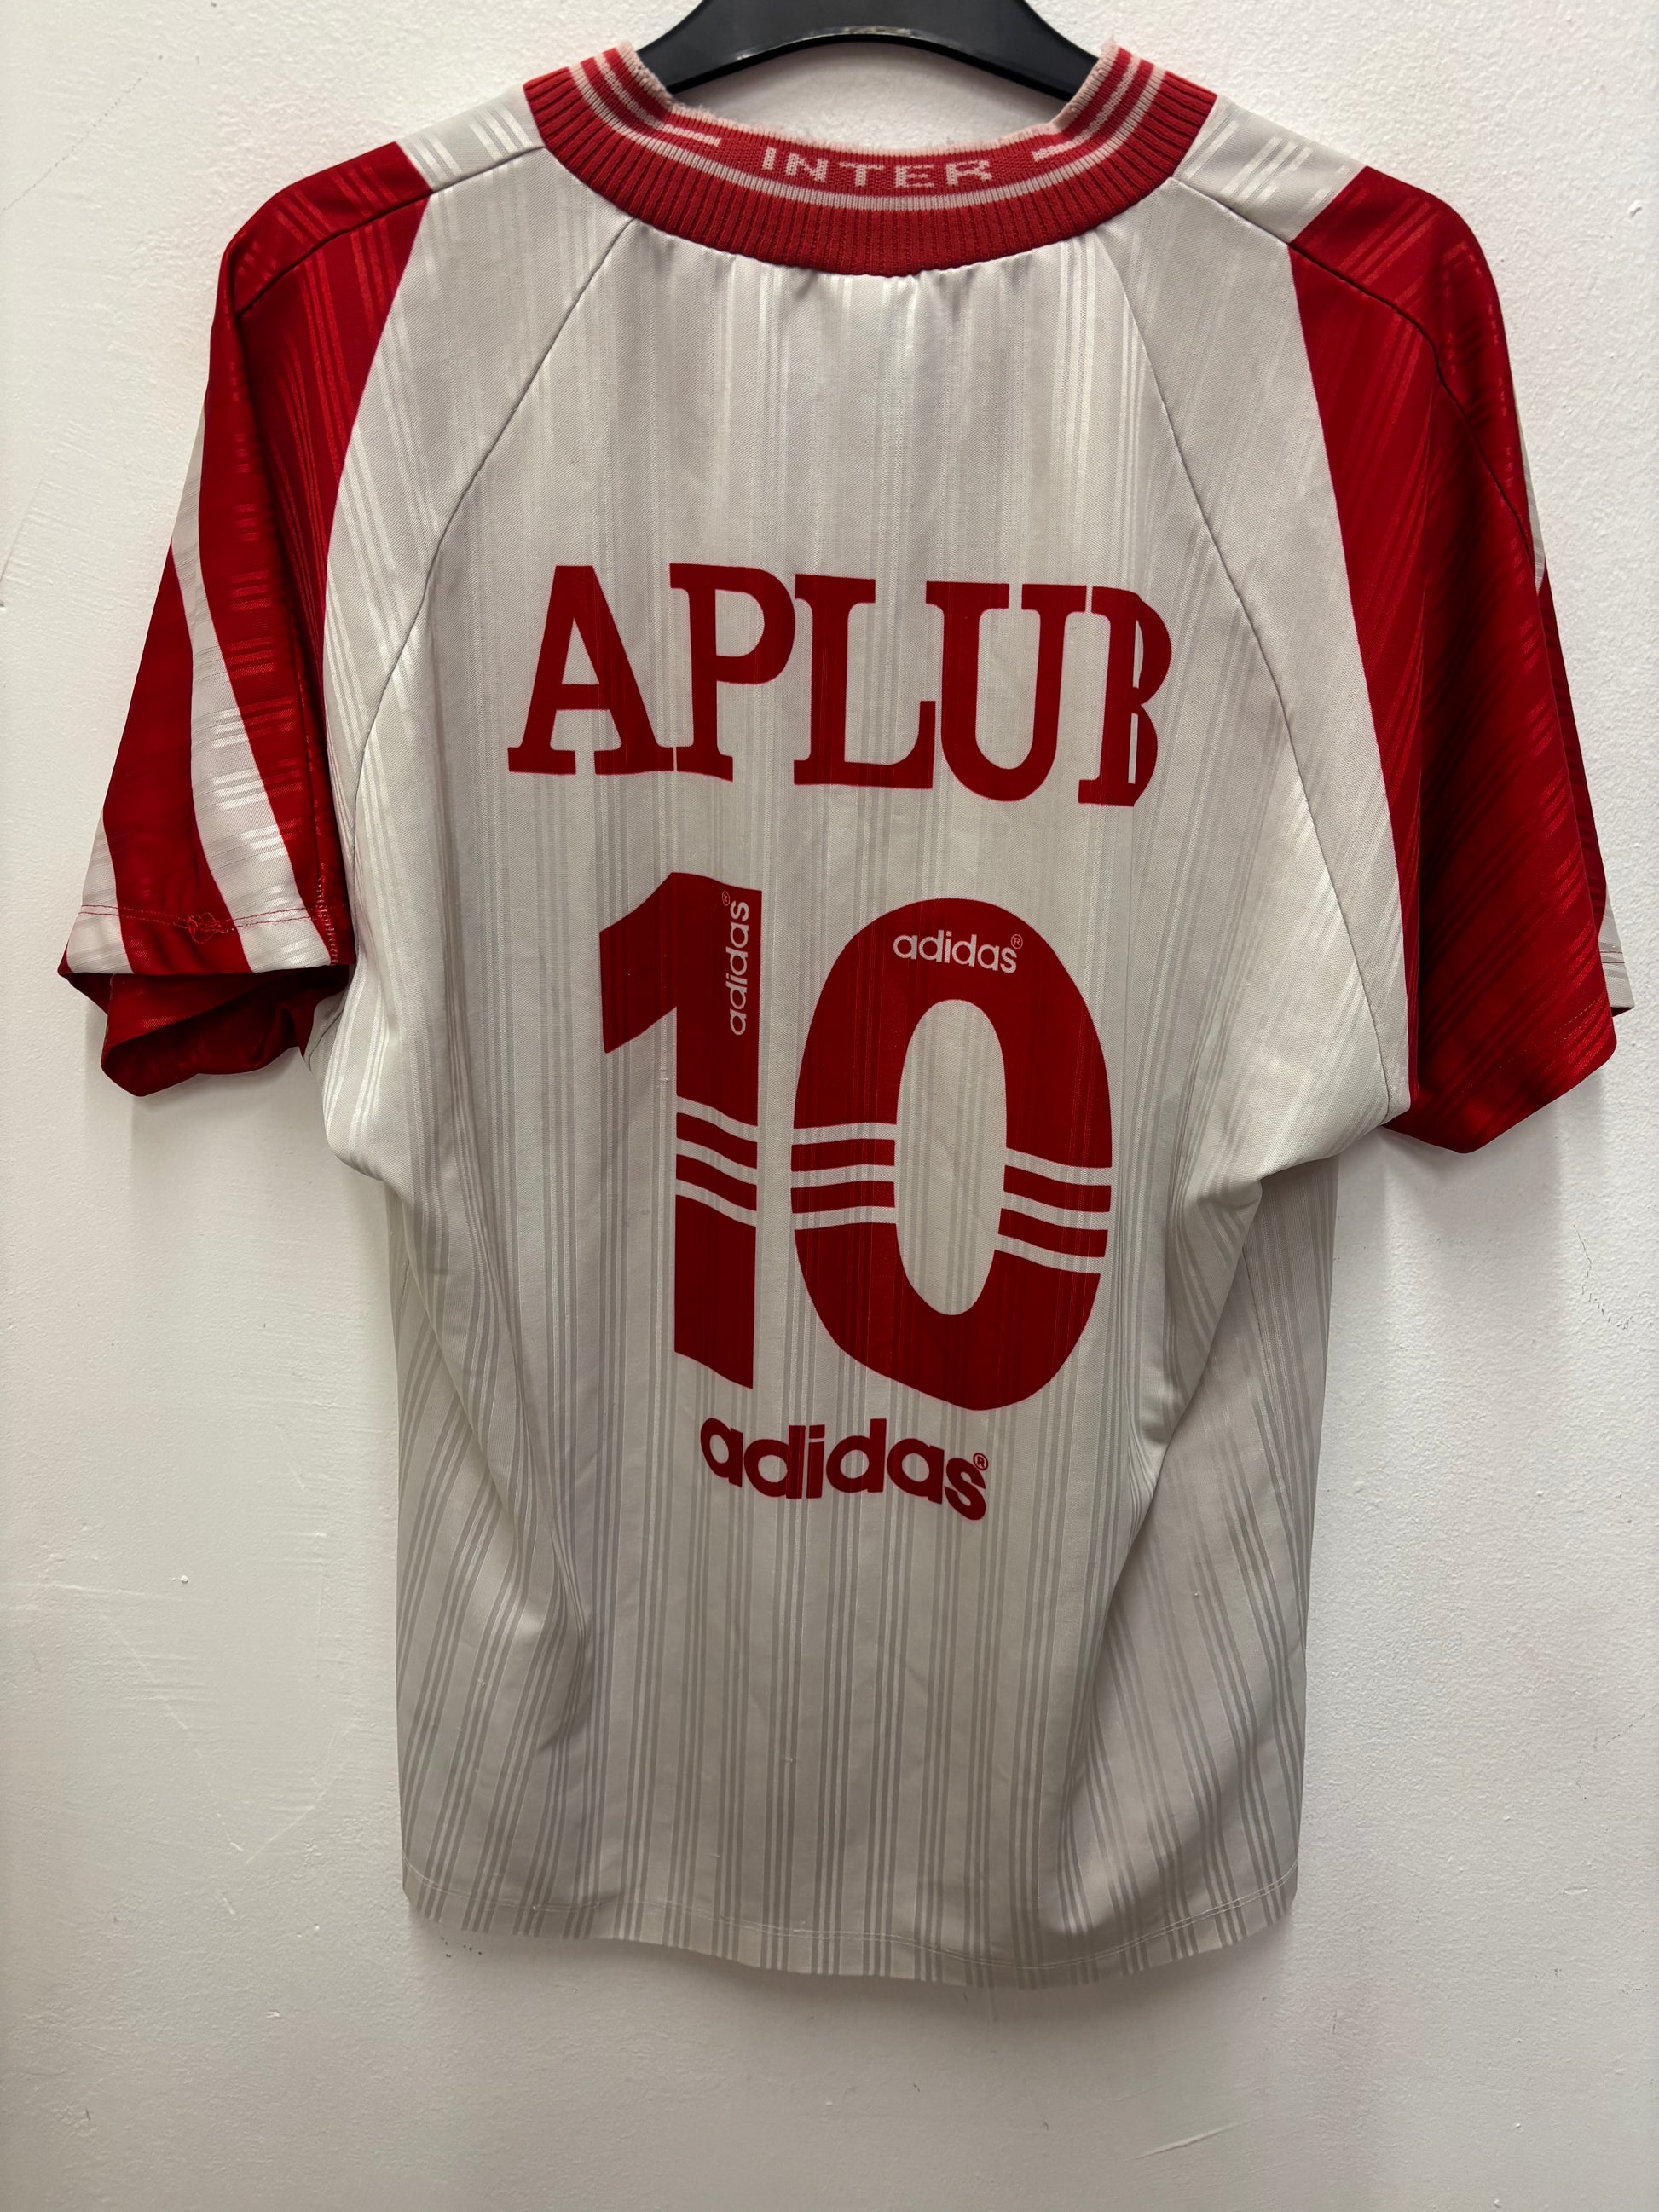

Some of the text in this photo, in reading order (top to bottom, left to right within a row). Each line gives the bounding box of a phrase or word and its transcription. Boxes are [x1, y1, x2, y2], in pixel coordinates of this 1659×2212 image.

[761, 145, 994, 189] INTER
[507, 563, 1172, 807] APLUB
[599, 872, 1113, 1411] 10
